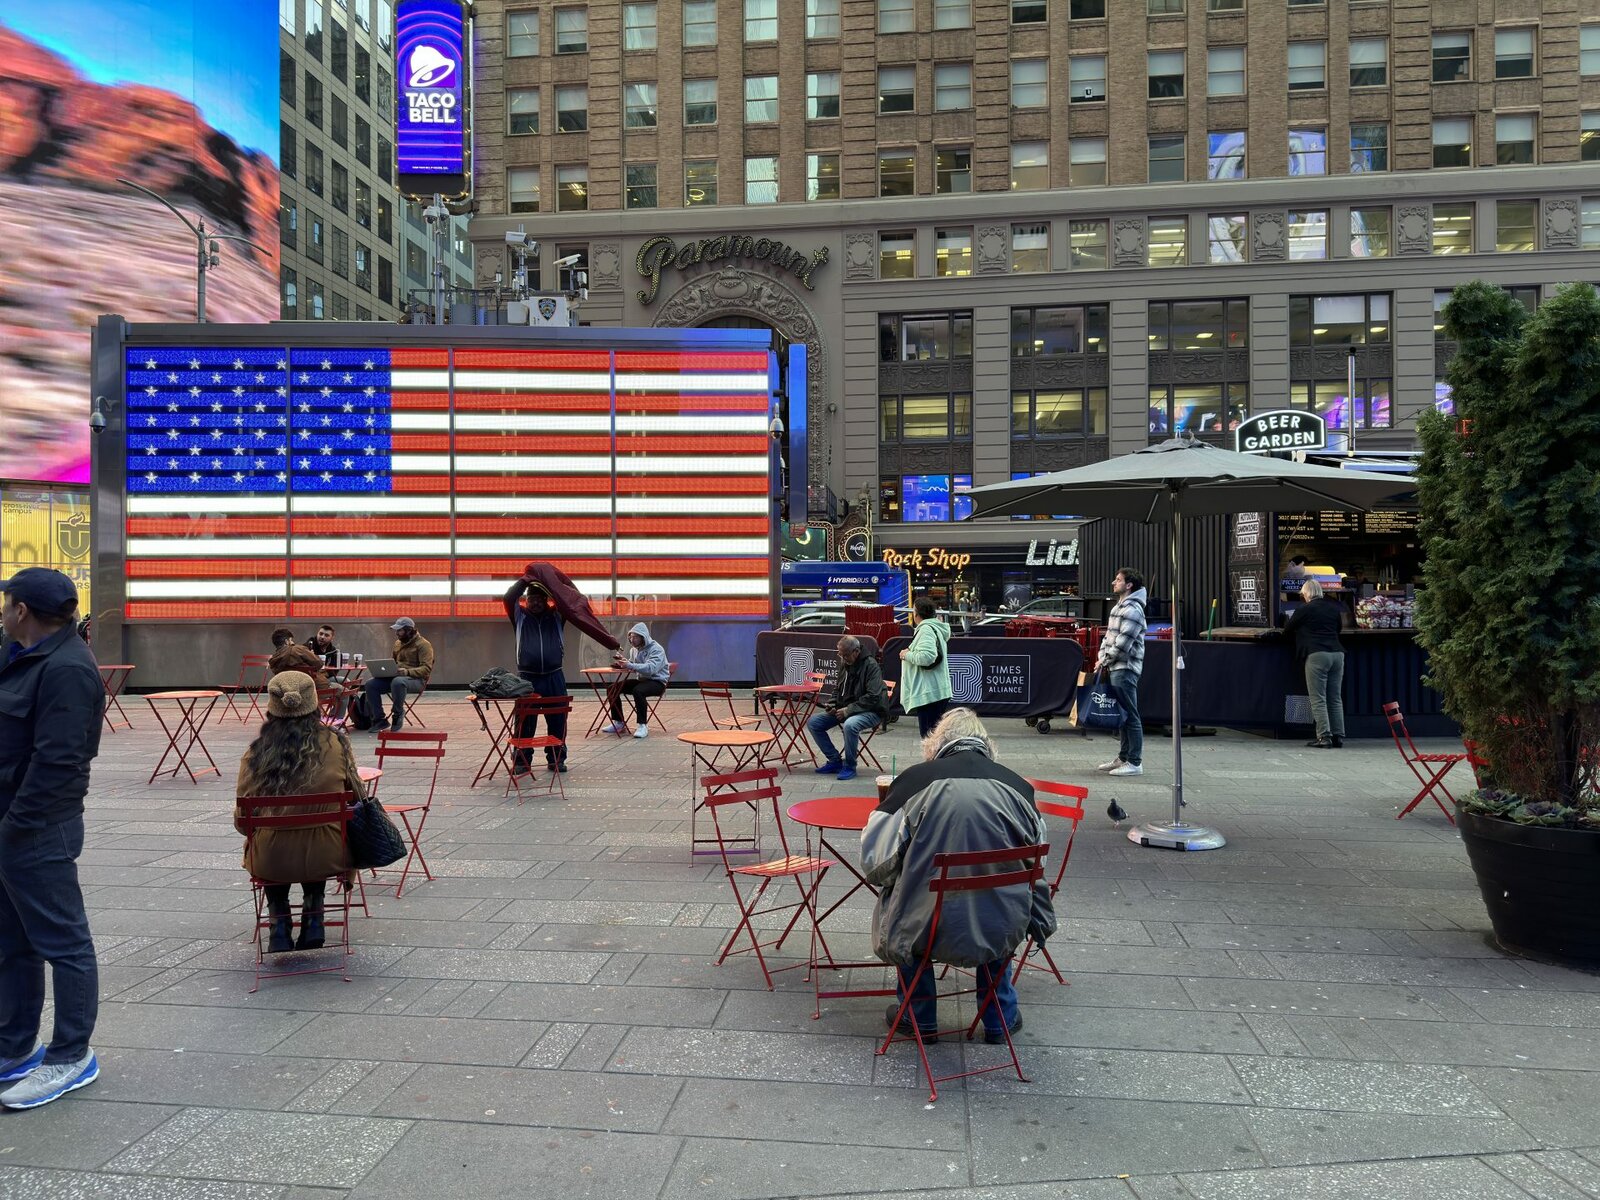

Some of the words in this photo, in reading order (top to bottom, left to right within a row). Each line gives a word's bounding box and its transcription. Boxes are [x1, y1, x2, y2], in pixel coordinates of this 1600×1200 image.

[405, 92, 456, 108] TACO
[408, 108, 457, 124] BELL
[636, 234, 830, 305] Paramount
[1257, 415, 1301, 432] BEER
[1245, 431, 1315, 449] GARDEN
[882, 548, 923, 570] Rock
[926, 548, 971, 570] Shop
[1241, 580, 1254, 589] BEER
[817, 658, 838, 668] TIMES
[989, 665, 1021, 675] TIMES
[986, 675, 1025, 686] SQUARE
[988, 686, 1023, 694] ALLIANCE
